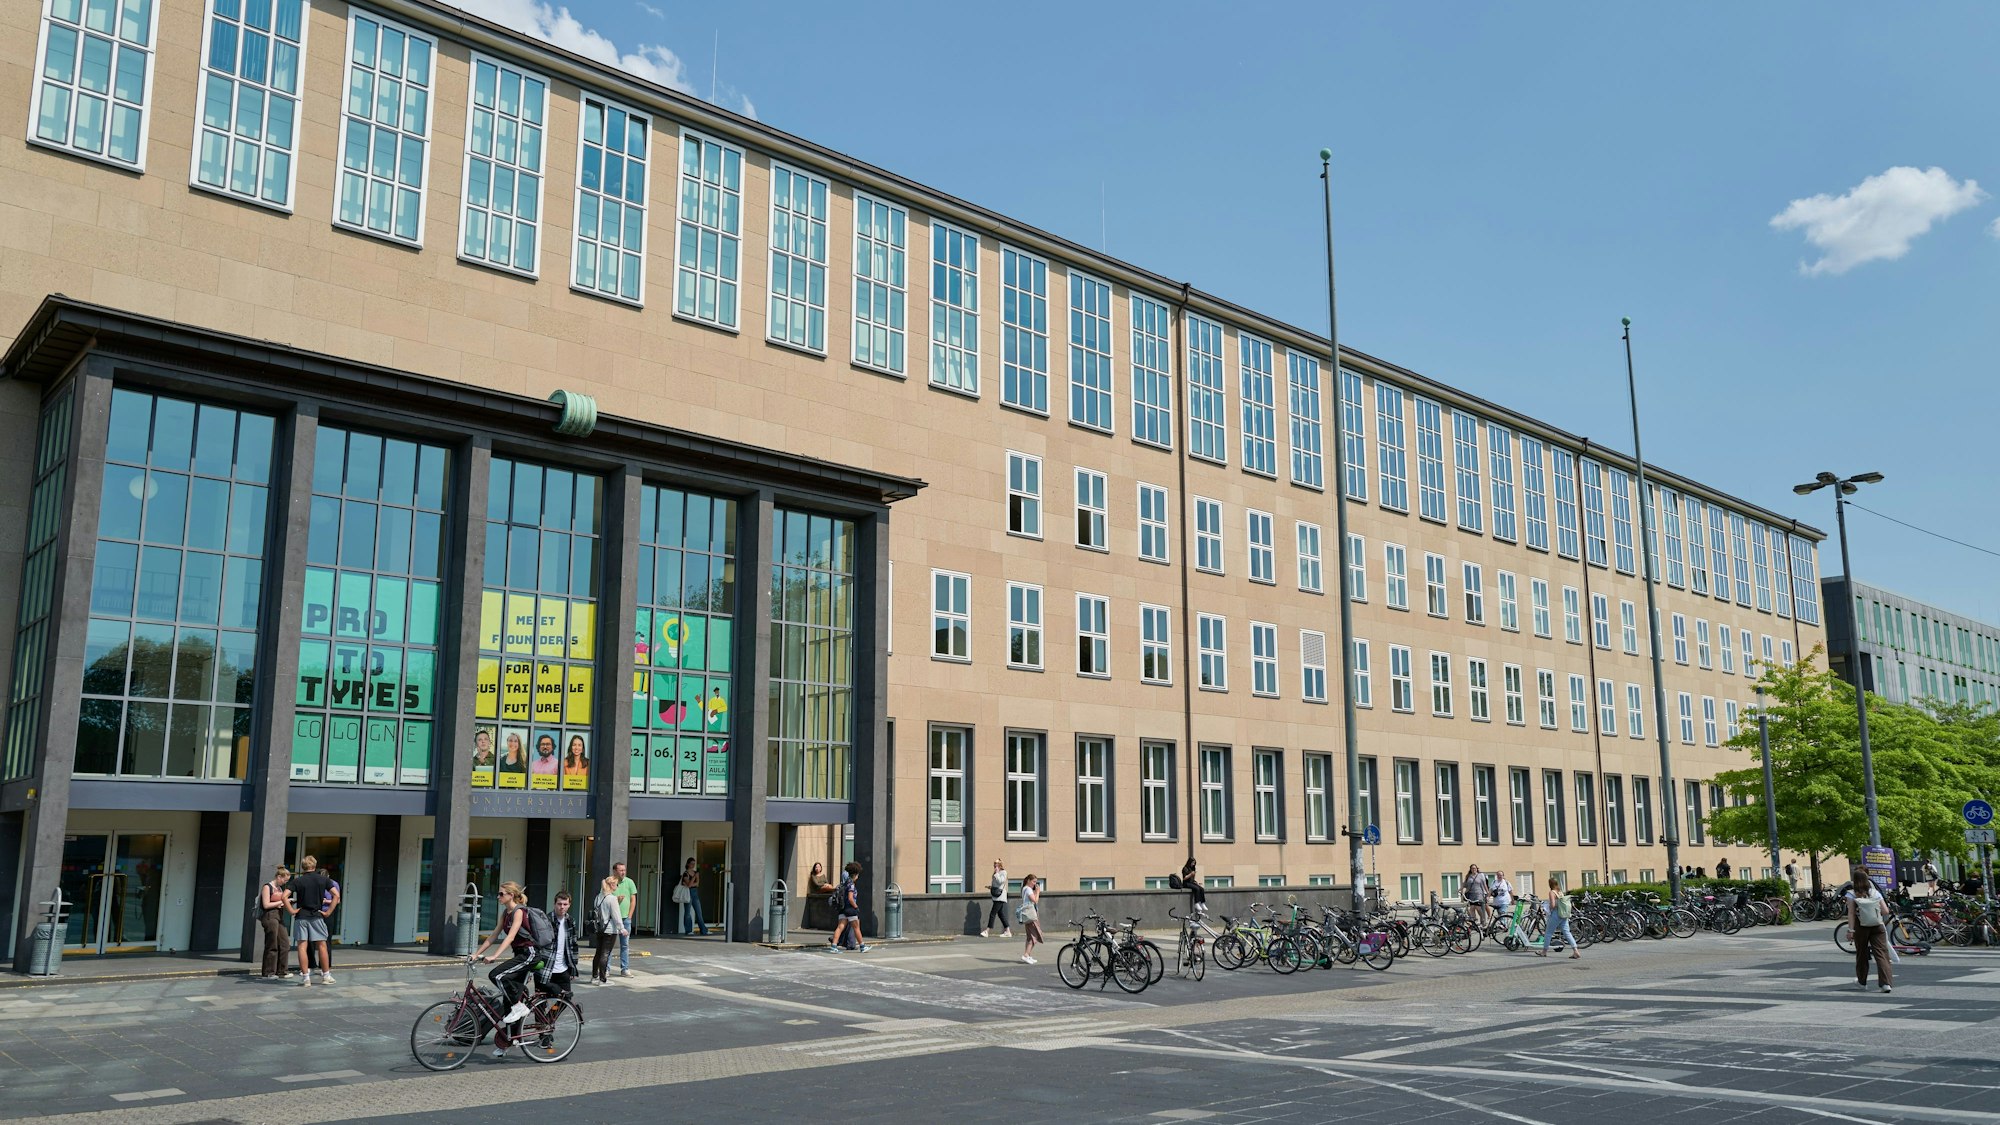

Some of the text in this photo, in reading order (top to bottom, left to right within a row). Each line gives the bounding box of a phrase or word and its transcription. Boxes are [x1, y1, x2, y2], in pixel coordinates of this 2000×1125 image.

[306, 603, 388, 635] PRO
[516, 615, 556, 626] MEET
[492, 634, 579, 645] FOUNDERS
[337, 648, 385, 676] TO
[505, 664, 549, 674] FOR A
[301, 676, 420, 709] TYPES
[504, 703, 560, 713] FUTURE
[297, 719, 418, 743] COLOGNE
[654, 747, 673, 758] 06.
[684, 750, 697, 762] 23
[472, 795, 583, 807] UNIVERSITÄT
